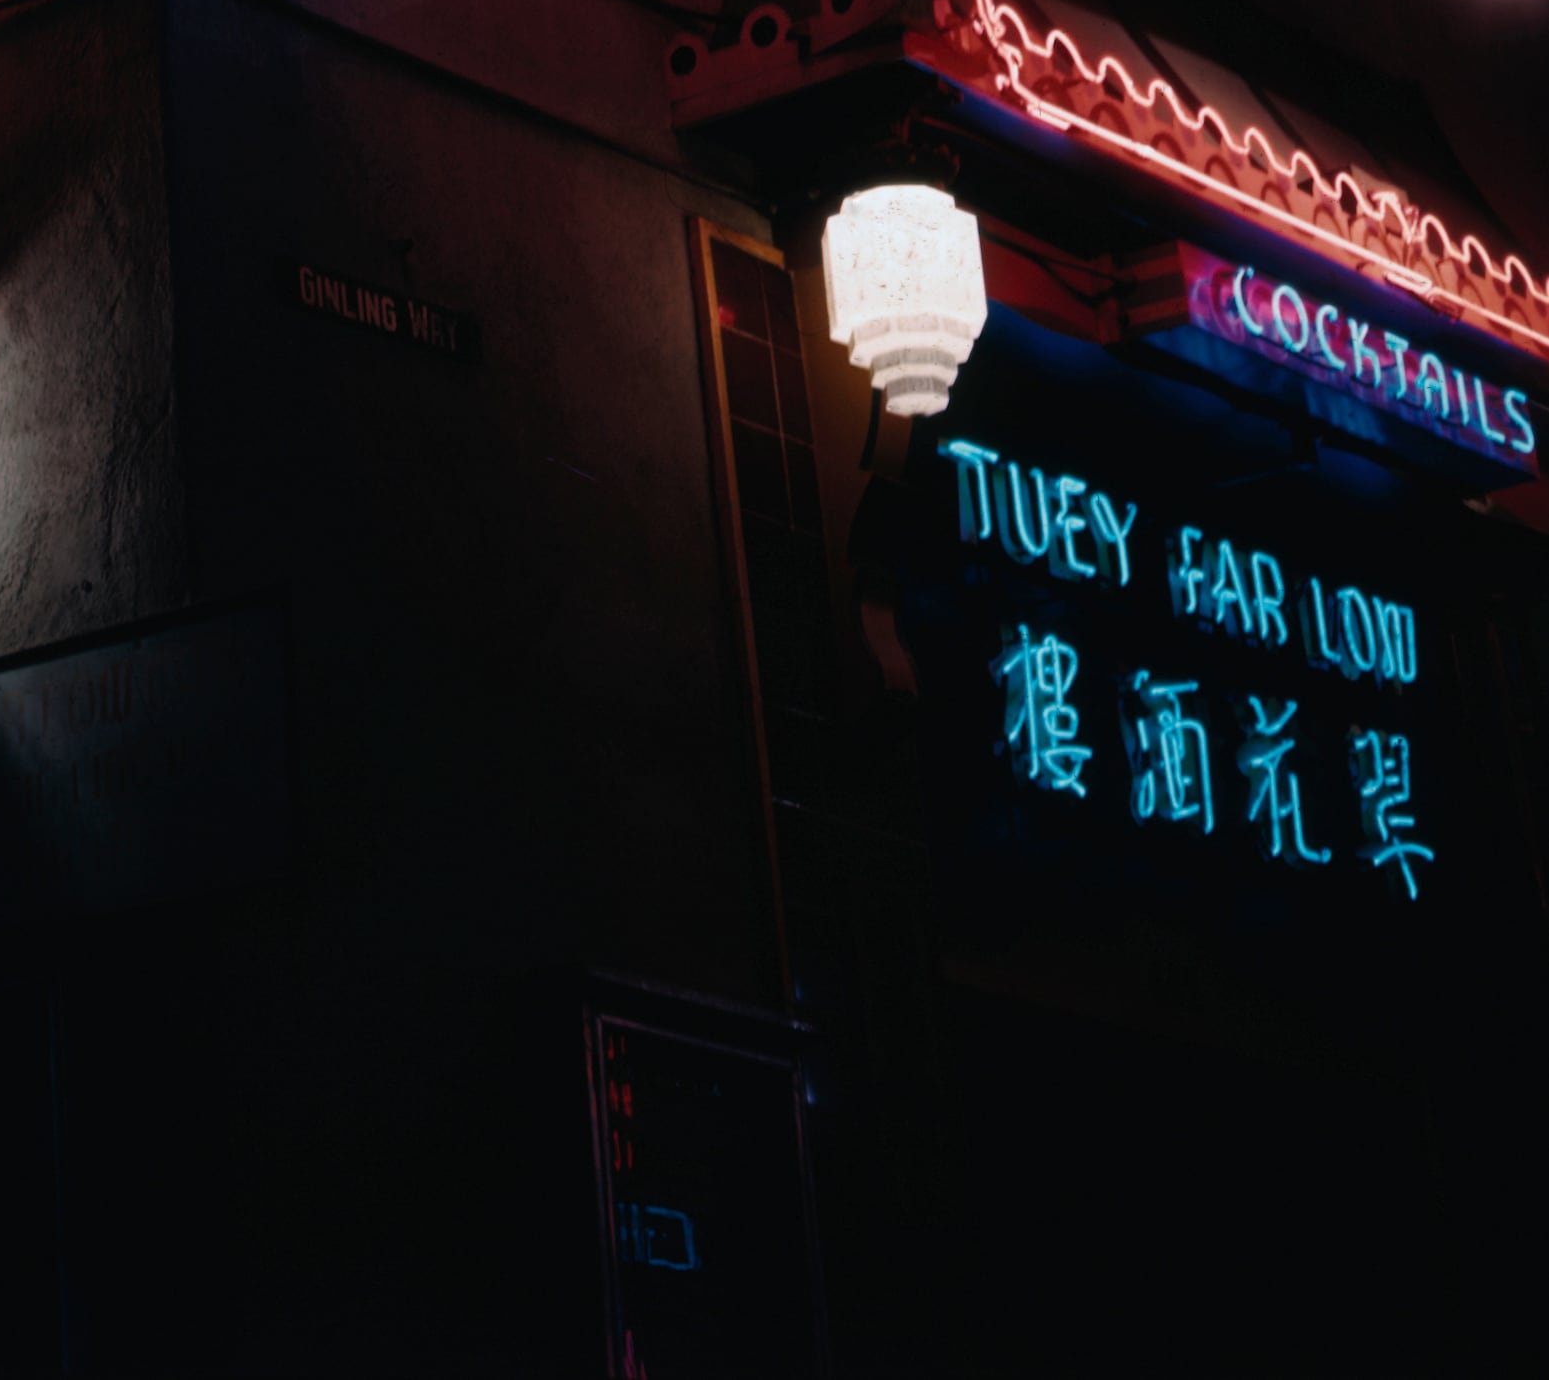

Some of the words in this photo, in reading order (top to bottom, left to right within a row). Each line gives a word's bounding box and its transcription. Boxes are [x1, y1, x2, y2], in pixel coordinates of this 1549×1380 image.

[298, 263, 398, 334] GINLING
[406, 298, 459, 352] WAY
[1231, 265, 1536, 454] COCKTAILS
[939, 440, 1137, 587] TUEY
[1177, 526, 1288, 646] FAR
[1308, 576, 1417, 684] LOW
